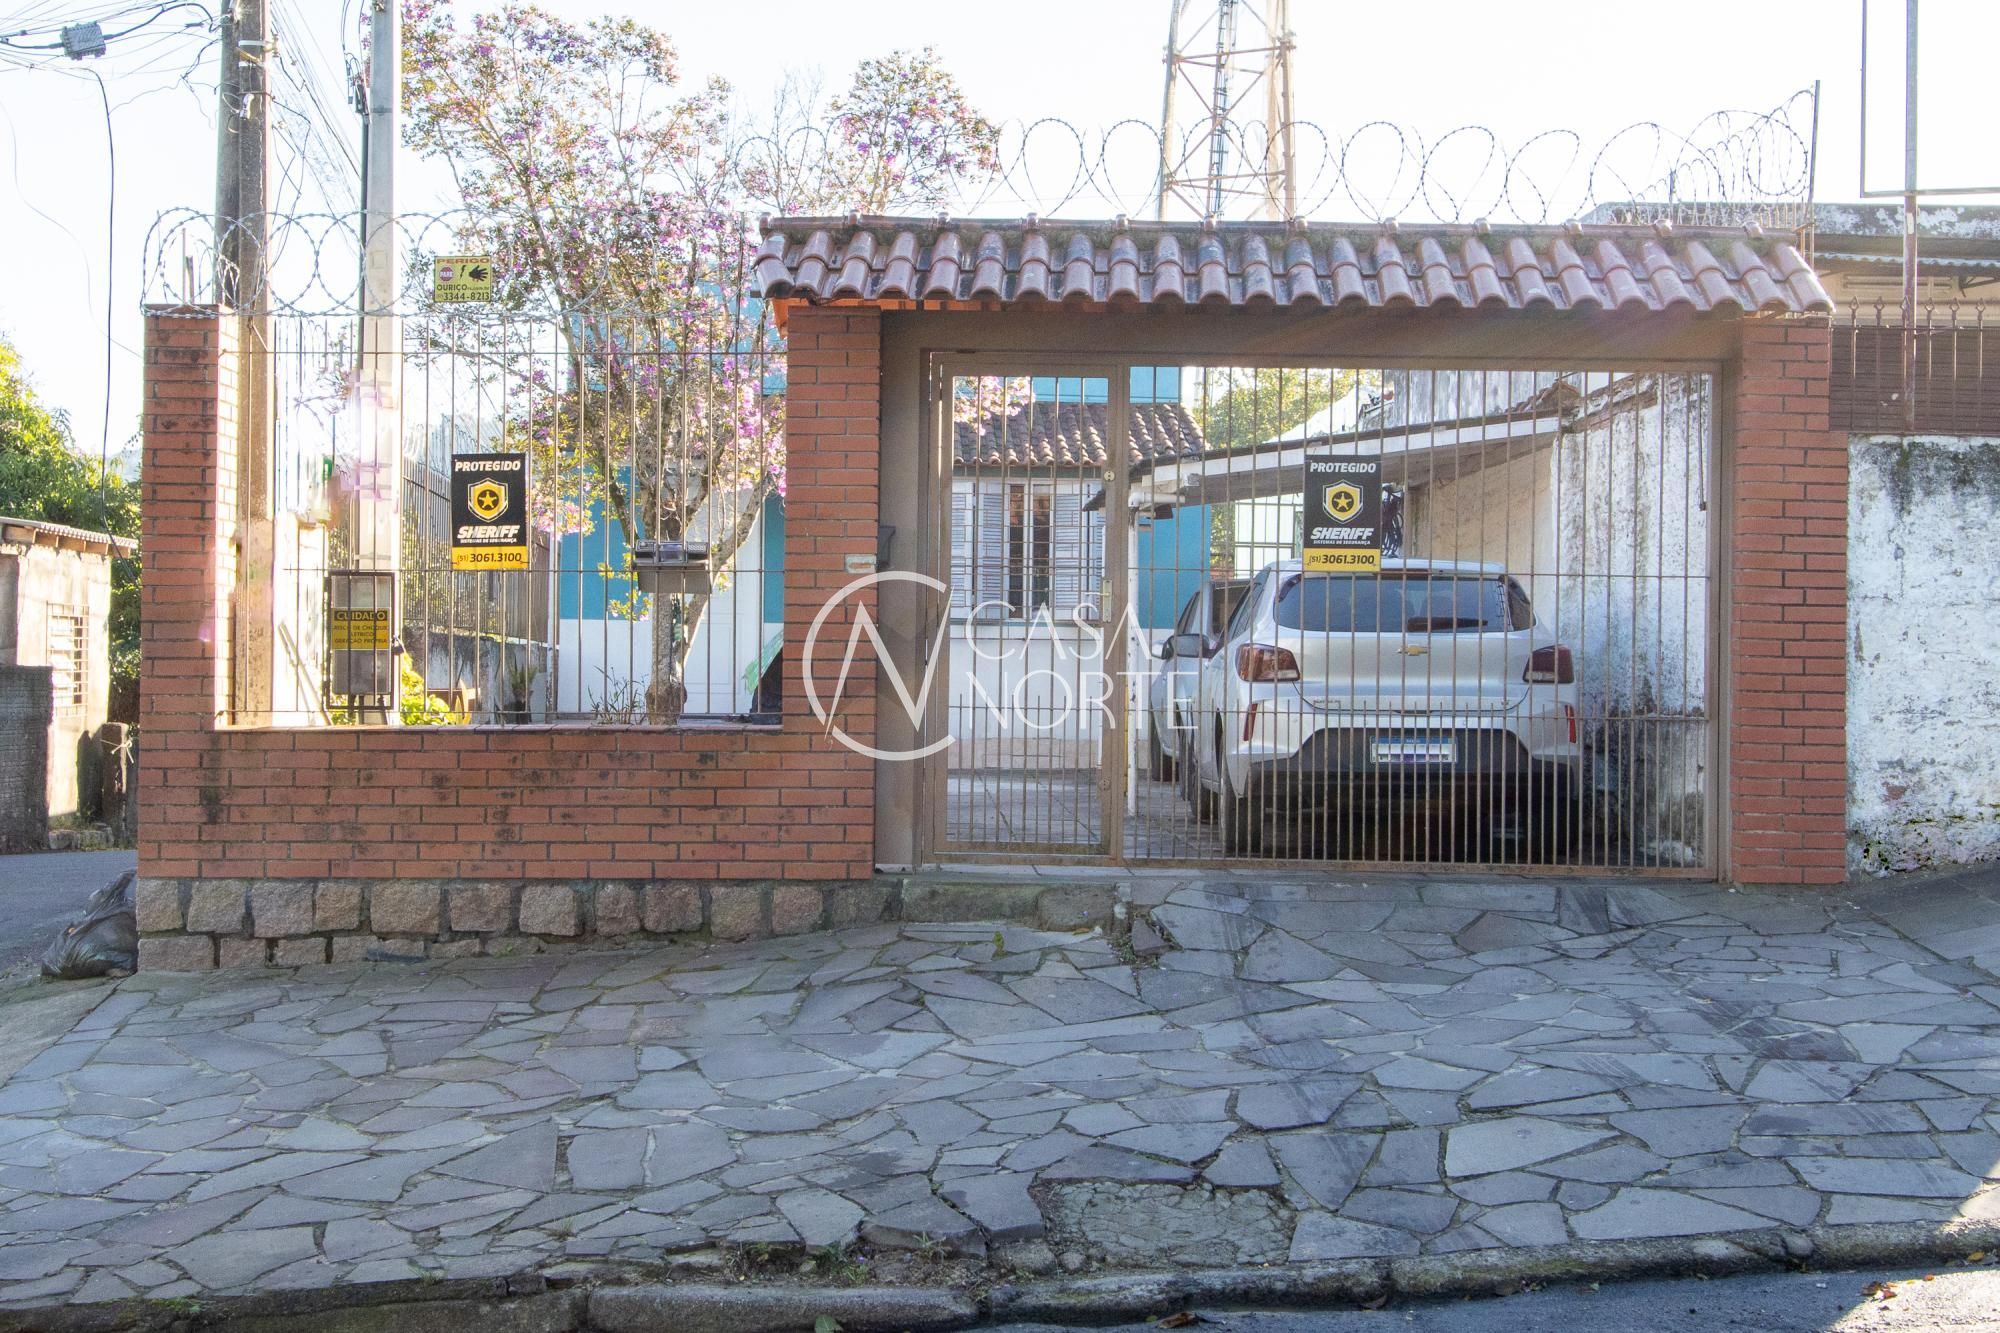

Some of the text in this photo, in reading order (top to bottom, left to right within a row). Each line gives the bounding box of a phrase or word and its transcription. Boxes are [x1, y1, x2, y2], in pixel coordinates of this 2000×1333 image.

[437, 284, 467, 292] OURIÇO
[443, 292, 490, 301] 3344-8213
[454, 460, 521, 472] PROTEGIDO
[1310, 462, 1377, 474] PROTEGIDO
[457, 524, 521, 539] SHERIFF
[1310, 526, 1375, 540] SHERIFF
[457, 553, 522, 563] (51) 3061.3100
[1310, 554, 1375, 564] (51) 3061.3100
[337, 611, 386, 621] CUIDADO
